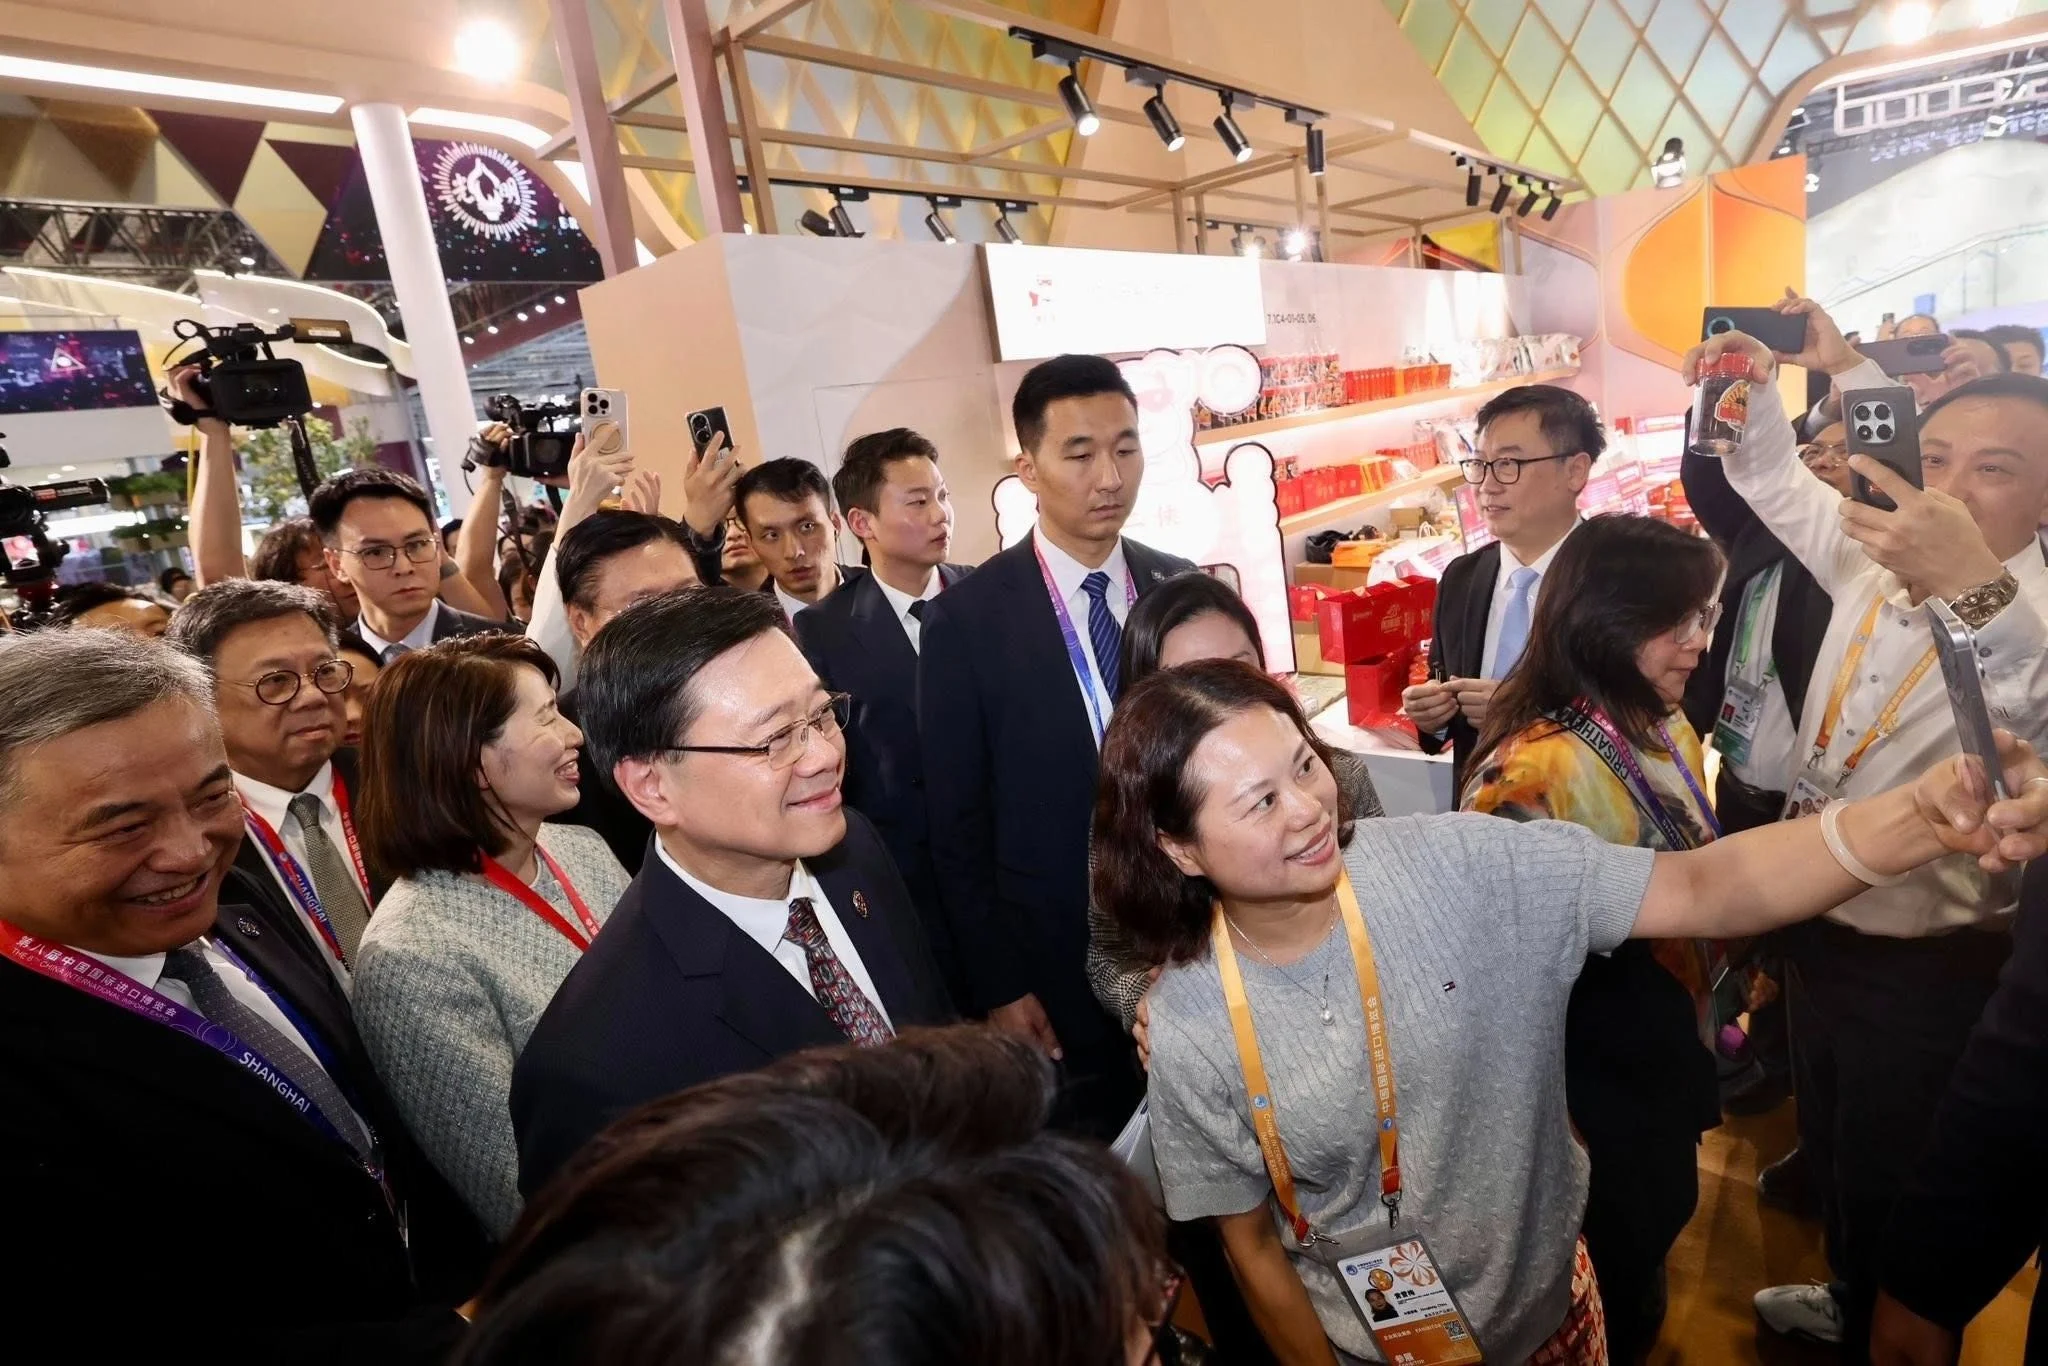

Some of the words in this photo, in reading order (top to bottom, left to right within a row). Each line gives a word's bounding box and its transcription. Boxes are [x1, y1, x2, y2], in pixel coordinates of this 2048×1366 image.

[11, 948, 27, 960] THE
[40, 961, 65, 977] CHINA
[64, 970, 121, 1001] INTERNATIONAL
[122, 998, 150, 1012] IMPORT
[149, 1009, 170, 1022] EXPO
[16, 935, 177, 1017] 第八届中国国际进口博览会
[238, 1051, 311, 1114] SHANGHAI
[1367, 996, 1391, 1113] 中国国际进口博览会
[1263, 1113, 1275, 1138] CHINA
